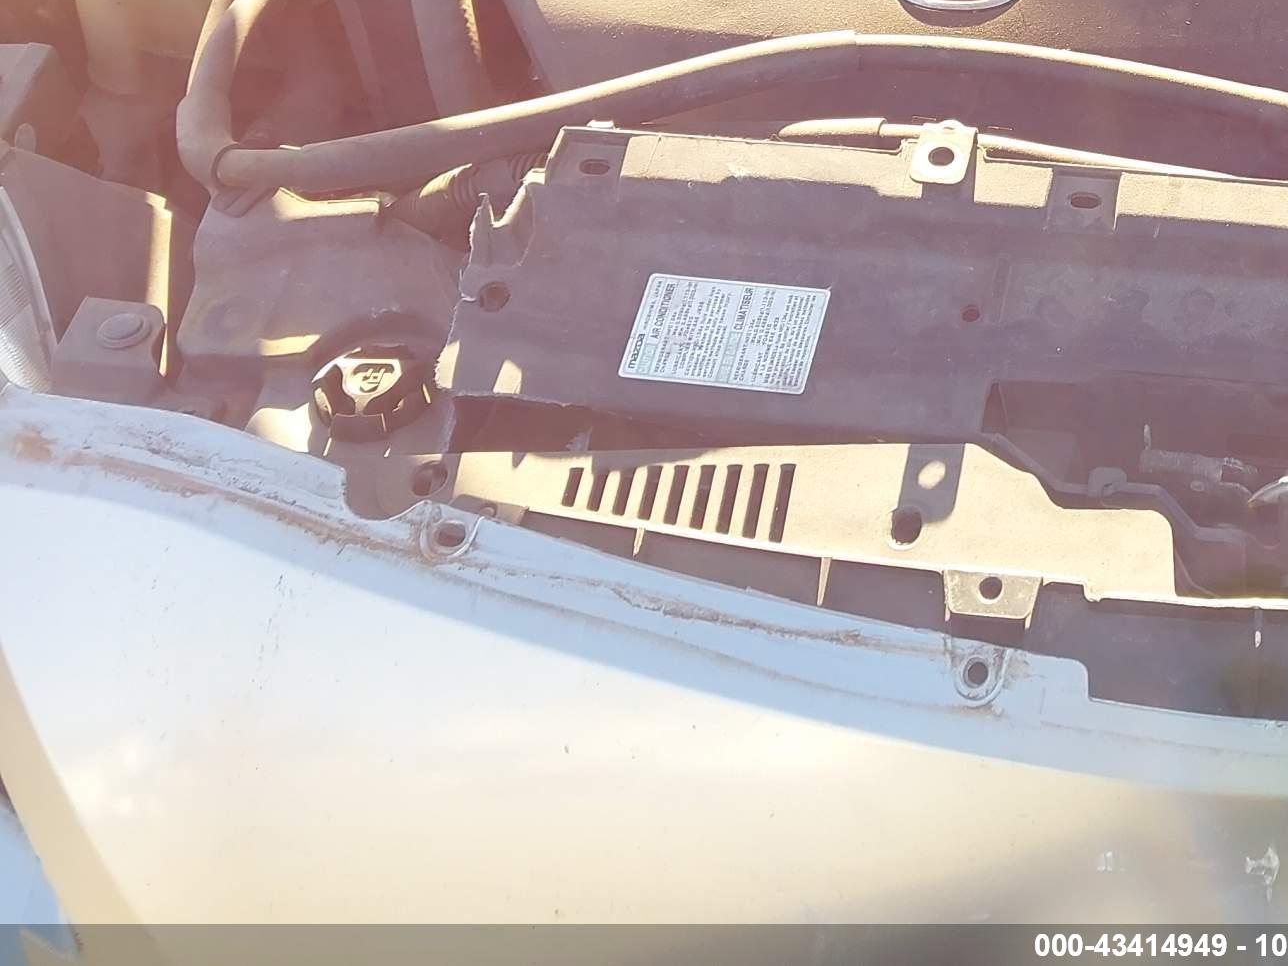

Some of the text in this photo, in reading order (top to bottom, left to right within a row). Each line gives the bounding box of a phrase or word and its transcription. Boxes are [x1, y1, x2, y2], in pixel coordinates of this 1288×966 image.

[650, 282, 676, 339] AIR CONDITIONER
[733, 287, 754, 330] CLIMATISEUR
[628, 333, 645, 368] mazda
